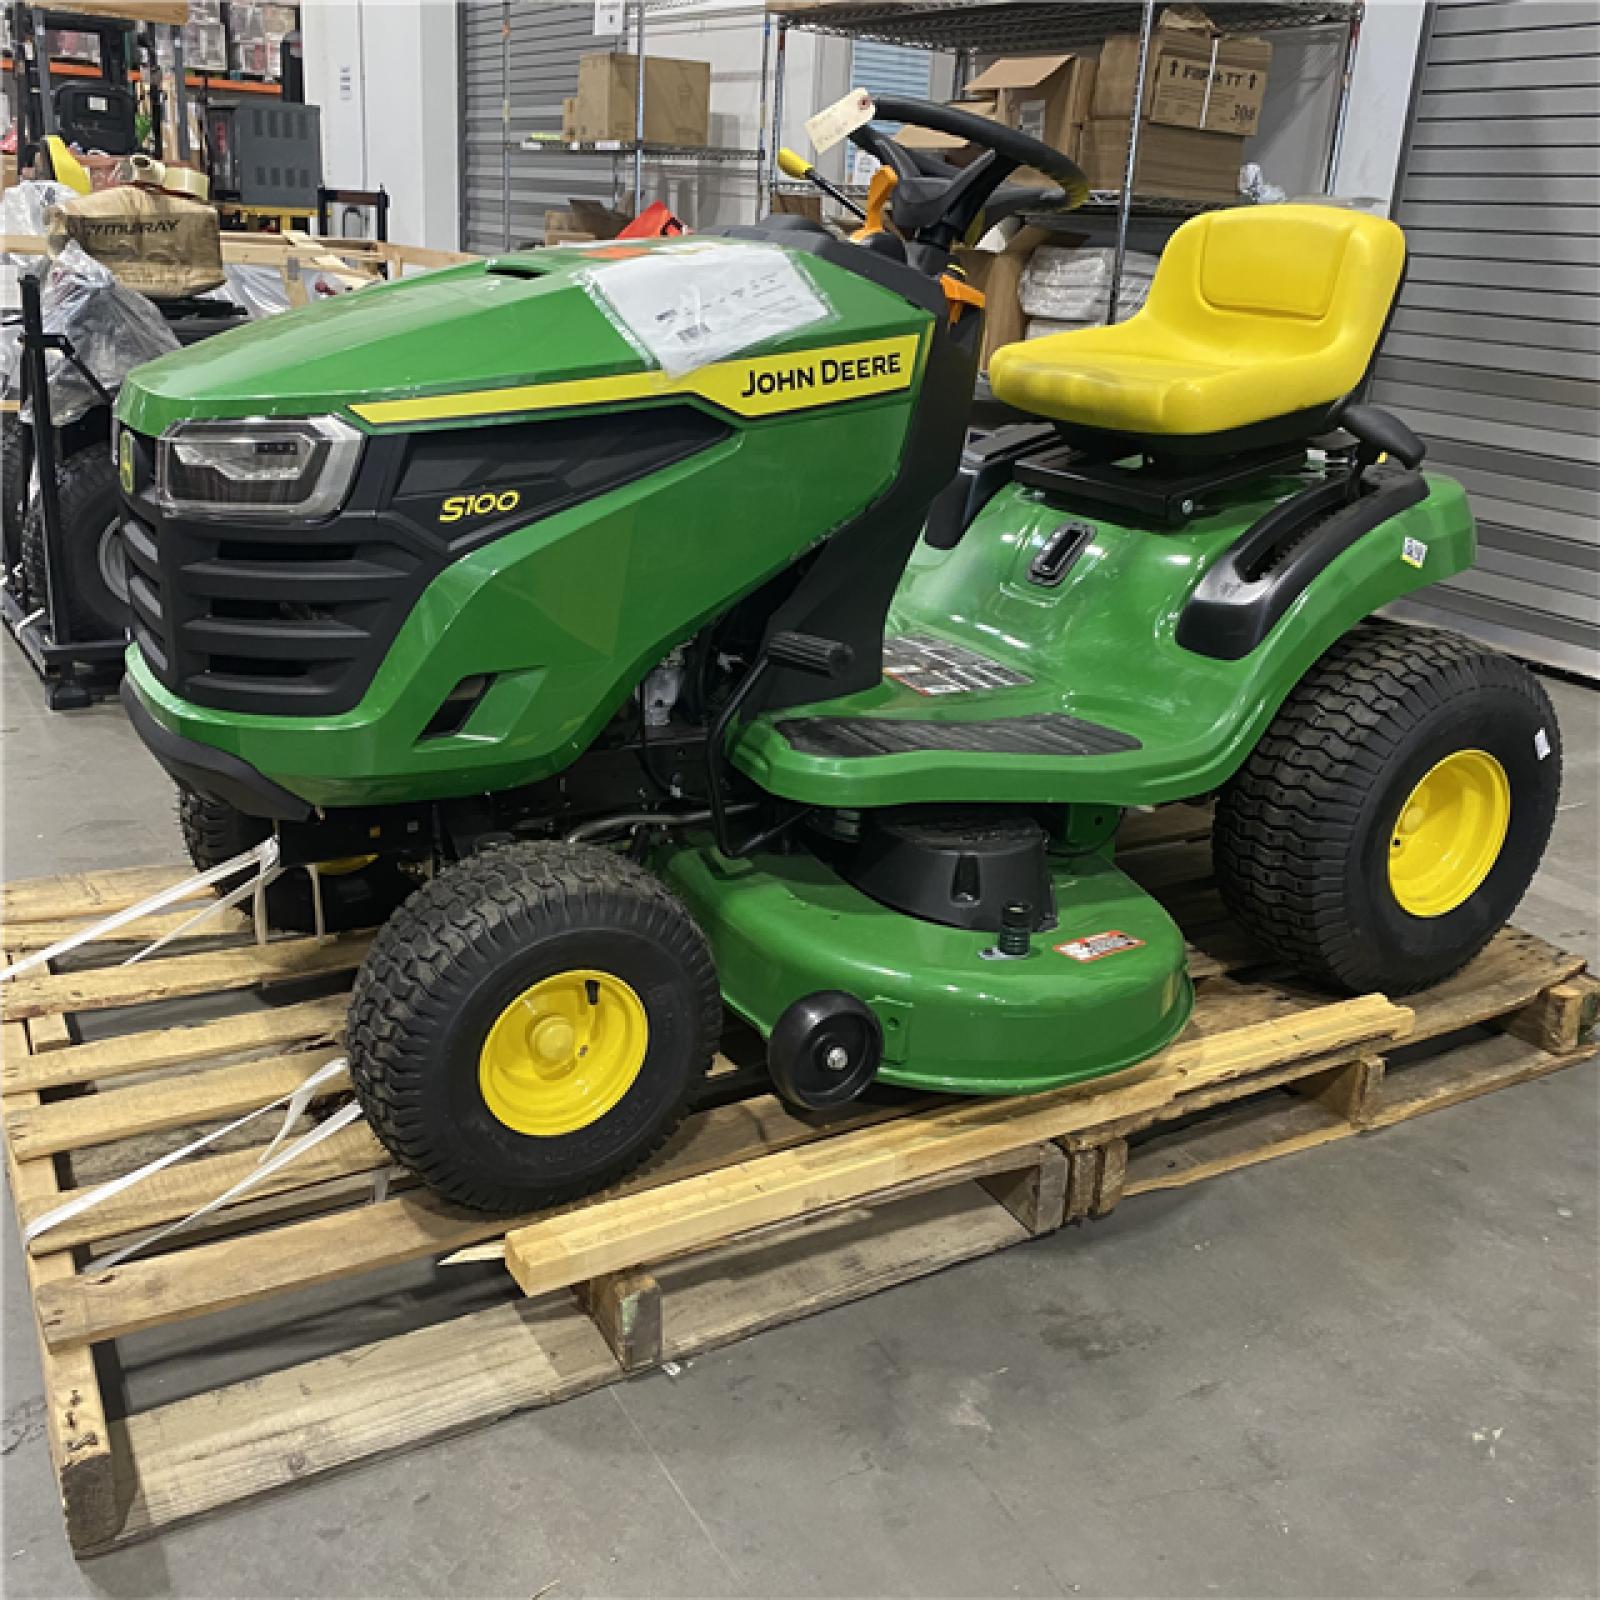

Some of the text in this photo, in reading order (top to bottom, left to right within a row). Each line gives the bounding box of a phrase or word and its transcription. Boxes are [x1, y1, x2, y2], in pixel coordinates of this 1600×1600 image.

[741, 351, 901, 398] JOHN DEERE
[439, 490, 520, 522] S100
